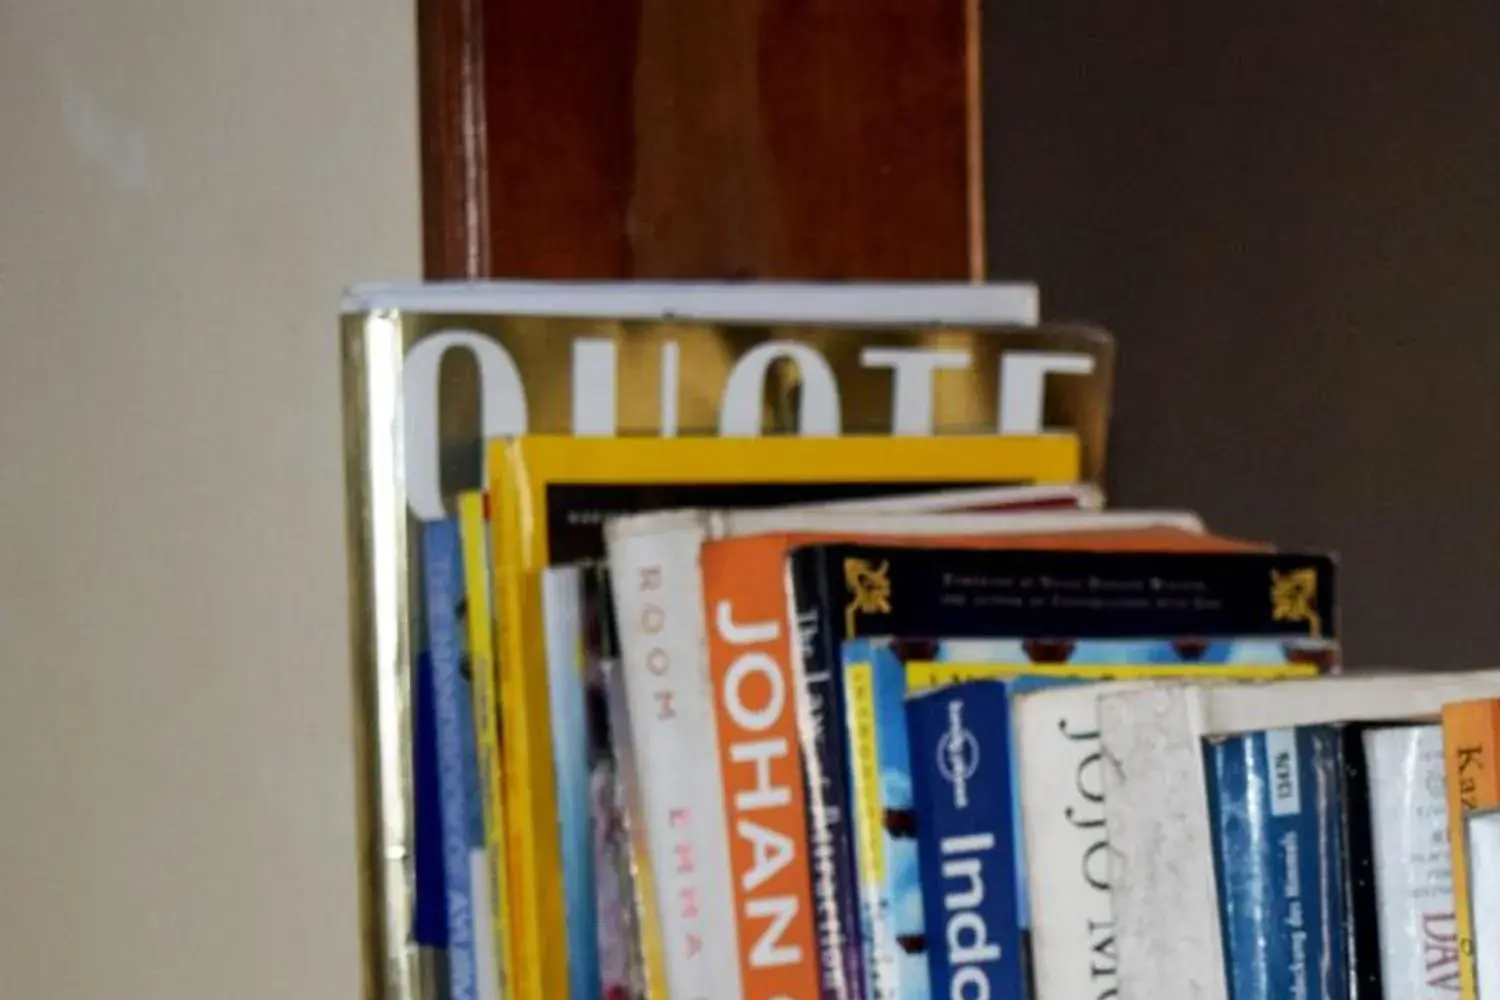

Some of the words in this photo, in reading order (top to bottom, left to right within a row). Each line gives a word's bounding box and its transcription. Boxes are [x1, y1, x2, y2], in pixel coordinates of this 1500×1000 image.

[638, 565, 678, 722] ROOM
[668, 808, 701, 958] EMMA
[716, 600, 802, 968] JOHAN
